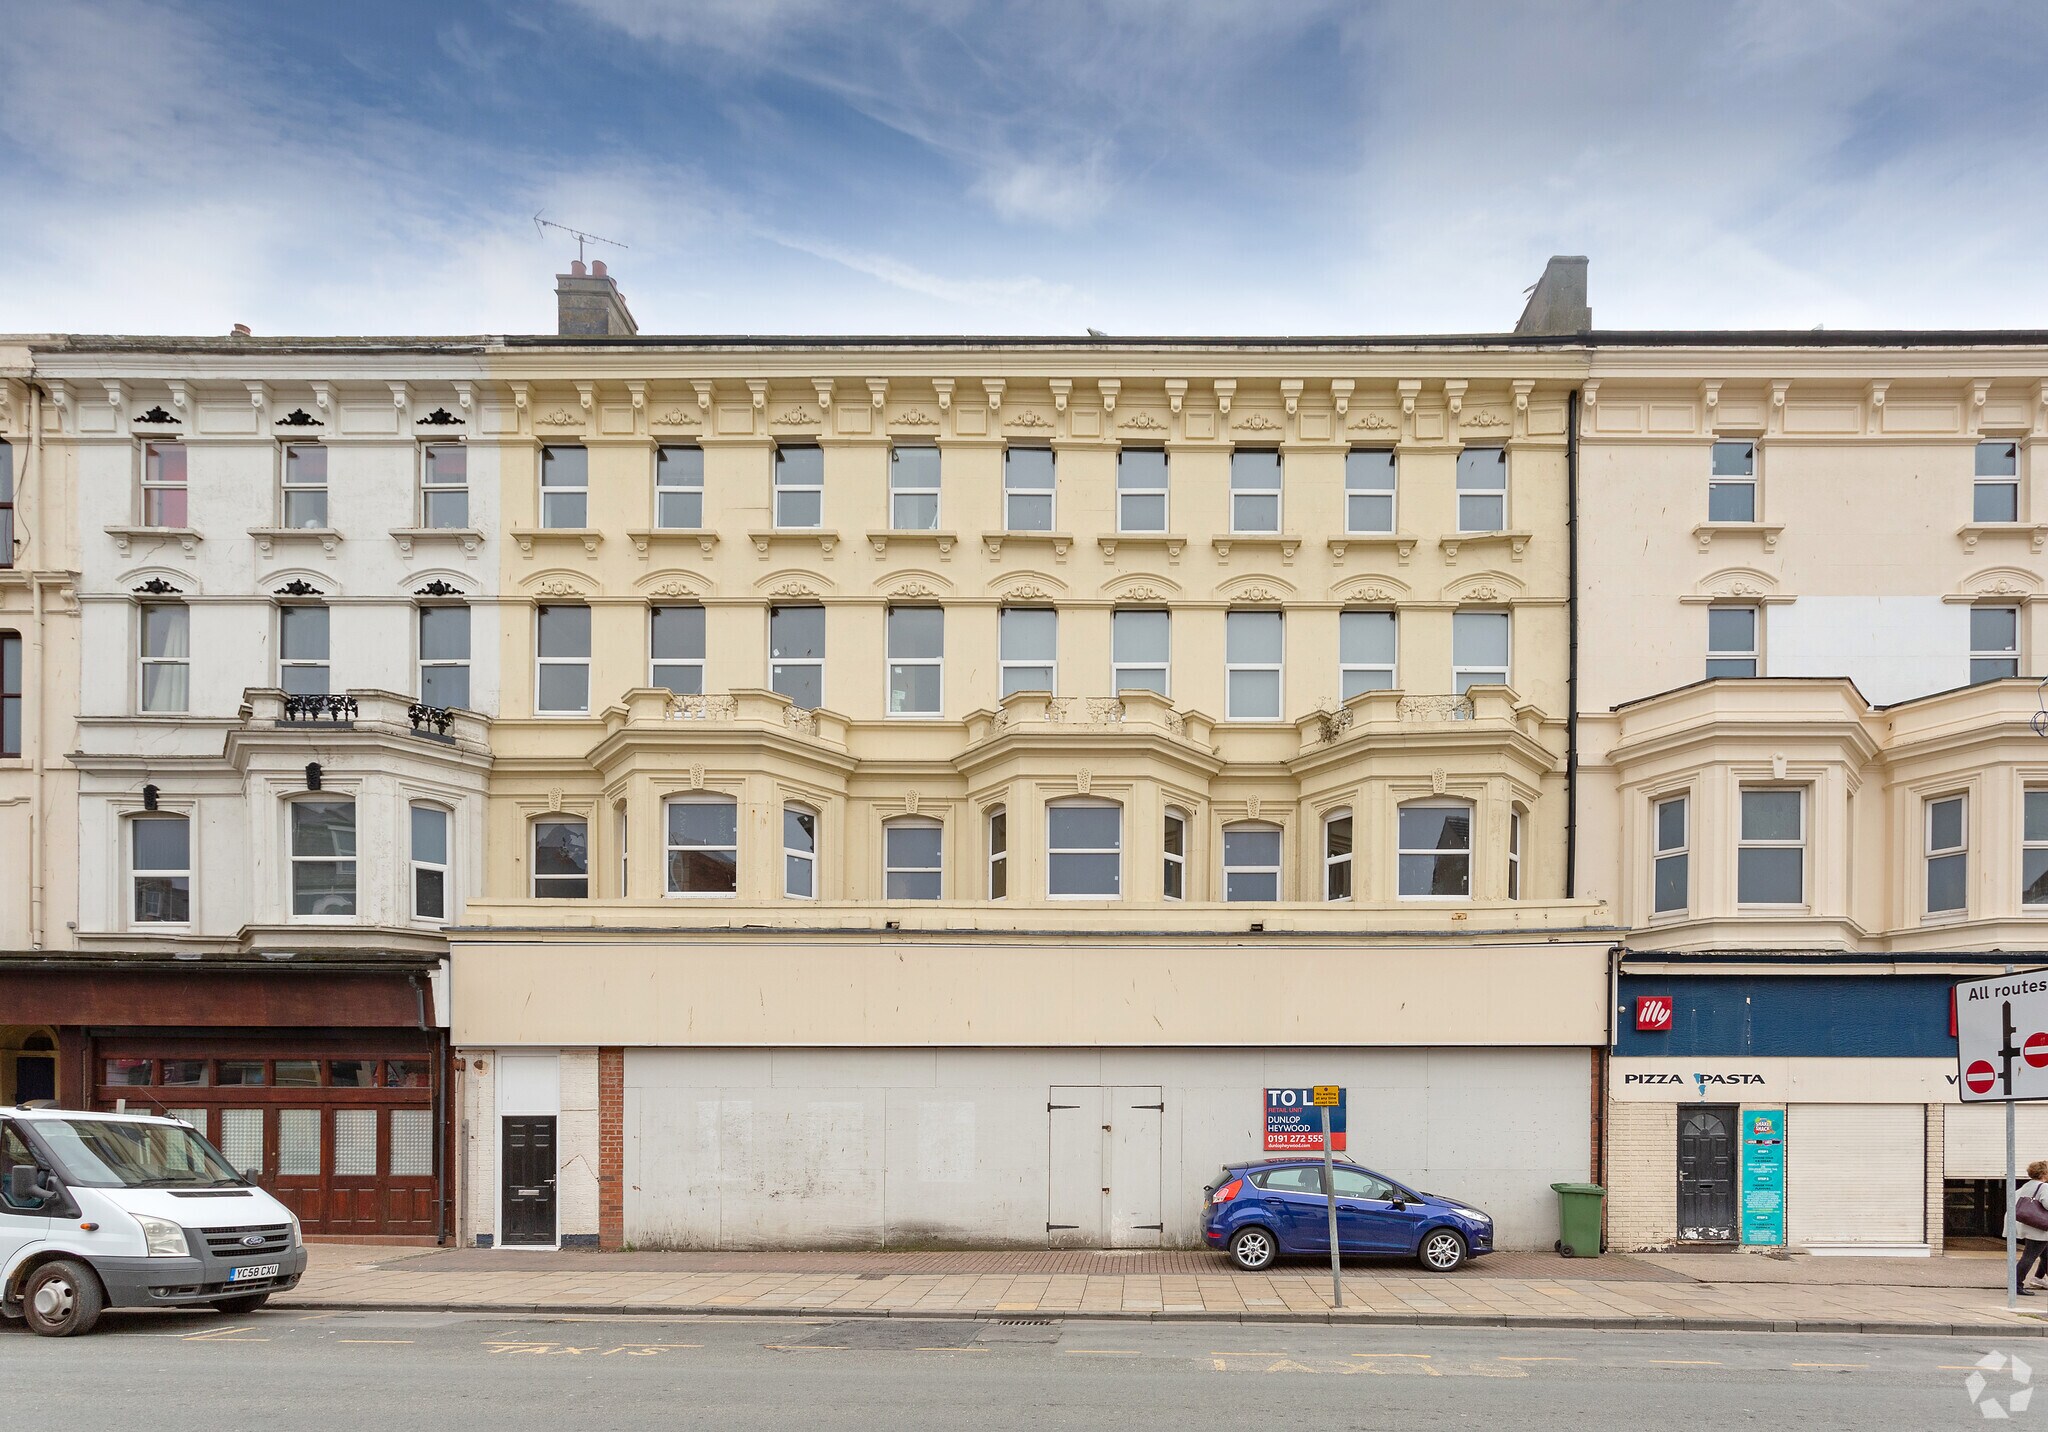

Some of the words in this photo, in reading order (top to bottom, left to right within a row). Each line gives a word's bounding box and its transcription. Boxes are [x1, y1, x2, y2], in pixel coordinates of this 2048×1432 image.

[1968, 986, 1989, 1001] All
[1995, 980, 2047, 998] routes
[1639, 1000, 1671, 1027] illy
[1624, 1074, 1684, 1085] PIZZA
[1699, 1074, 1766, 1085] PASTA
[1267, 1090, 1297, 1106] TO
[1267, 1116, 1301, 1124] DUNLOP
[1268, 1134, 1288, 1143] 0191
[1290, 1134, 1306, 1143] 272
[1308, 1134, 1324, 1143] 555
[237, 1267, 260, 1278] YC58
[260, 1265, 278, 1276] CXU
